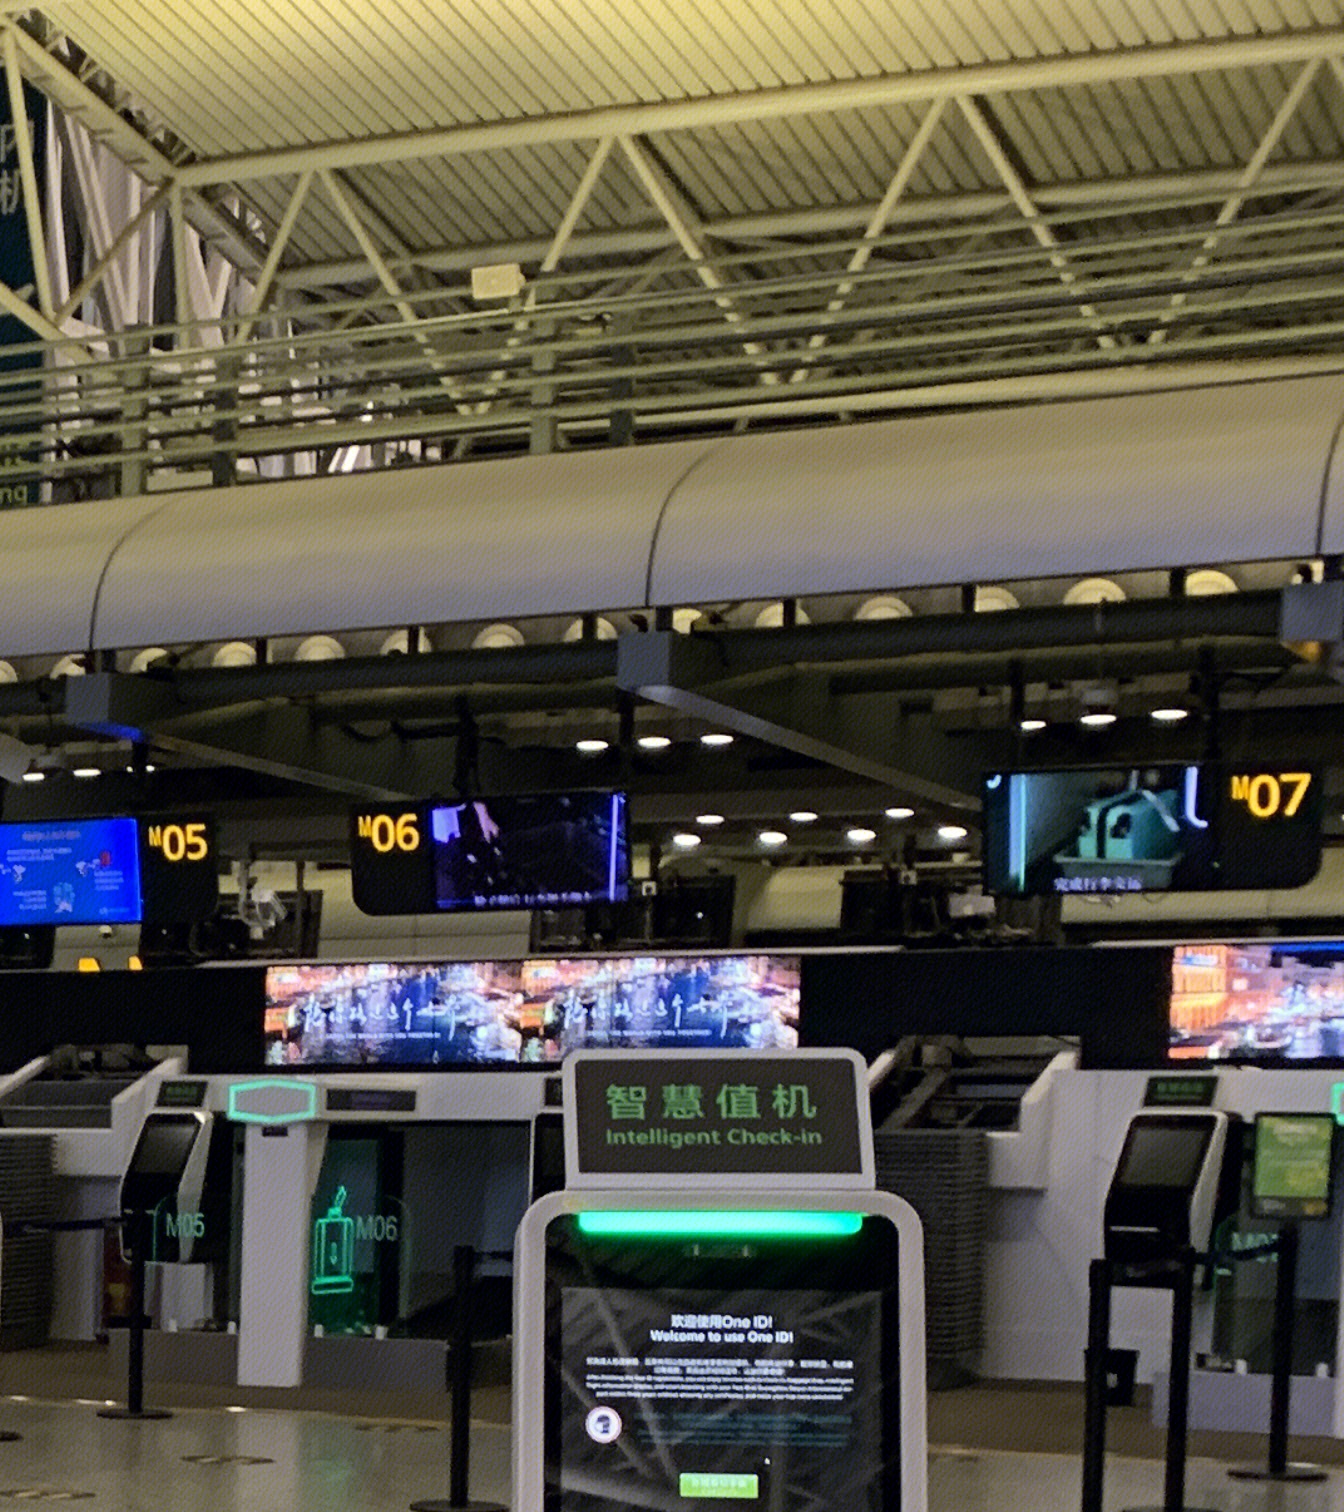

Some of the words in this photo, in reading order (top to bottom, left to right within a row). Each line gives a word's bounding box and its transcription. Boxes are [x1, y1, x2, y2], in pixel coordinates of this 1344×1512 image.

[1231, 772, 1312, 818] M07
[148, 823, 209, 862] M05
[358, 813, 420, 853] M06
[605, 1083, 817, 1121] 智慧值机
[605, 1127, 722, 1149] Intelligent
[726, 1127, 823, 1146] Check-in
[165, 1212, 206, 1238] M05
[355, 1215, 398, 1242] M06
[650, 1330, 706, 1343] Welcome
[747, 1331, 774, 1344] One
